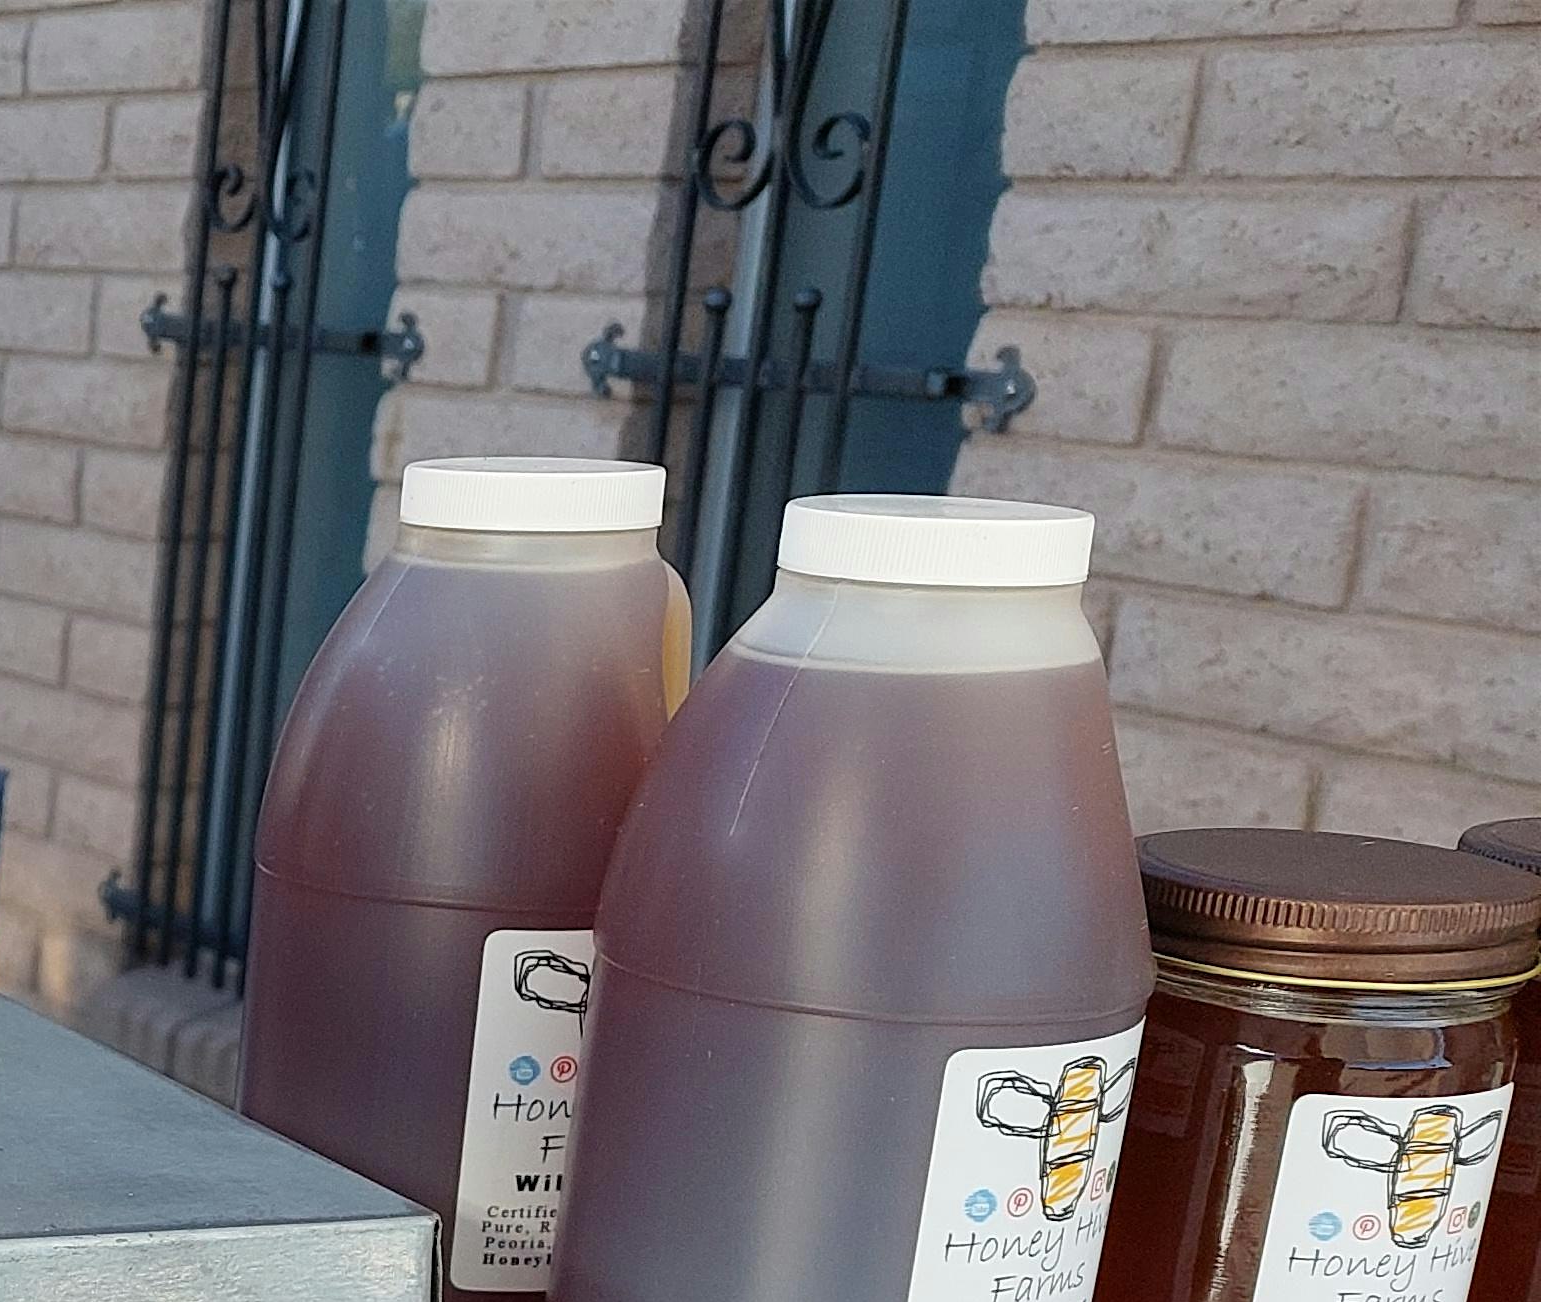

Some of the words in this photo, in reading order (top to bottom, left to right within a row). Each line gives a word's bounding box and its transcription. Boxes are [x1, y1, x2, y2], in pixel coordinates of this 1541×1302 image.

[493, 1093, 571, 1121] Hon
[487, 1206, 557, 1218] Certifie
[482, 1221, 529, 1234] Pure,
[485, 1237, 551, 1249] Peoria,
[945, 1228, 1065, 1271] Honey
[1289, 1247, 1417, 1292] Honey
